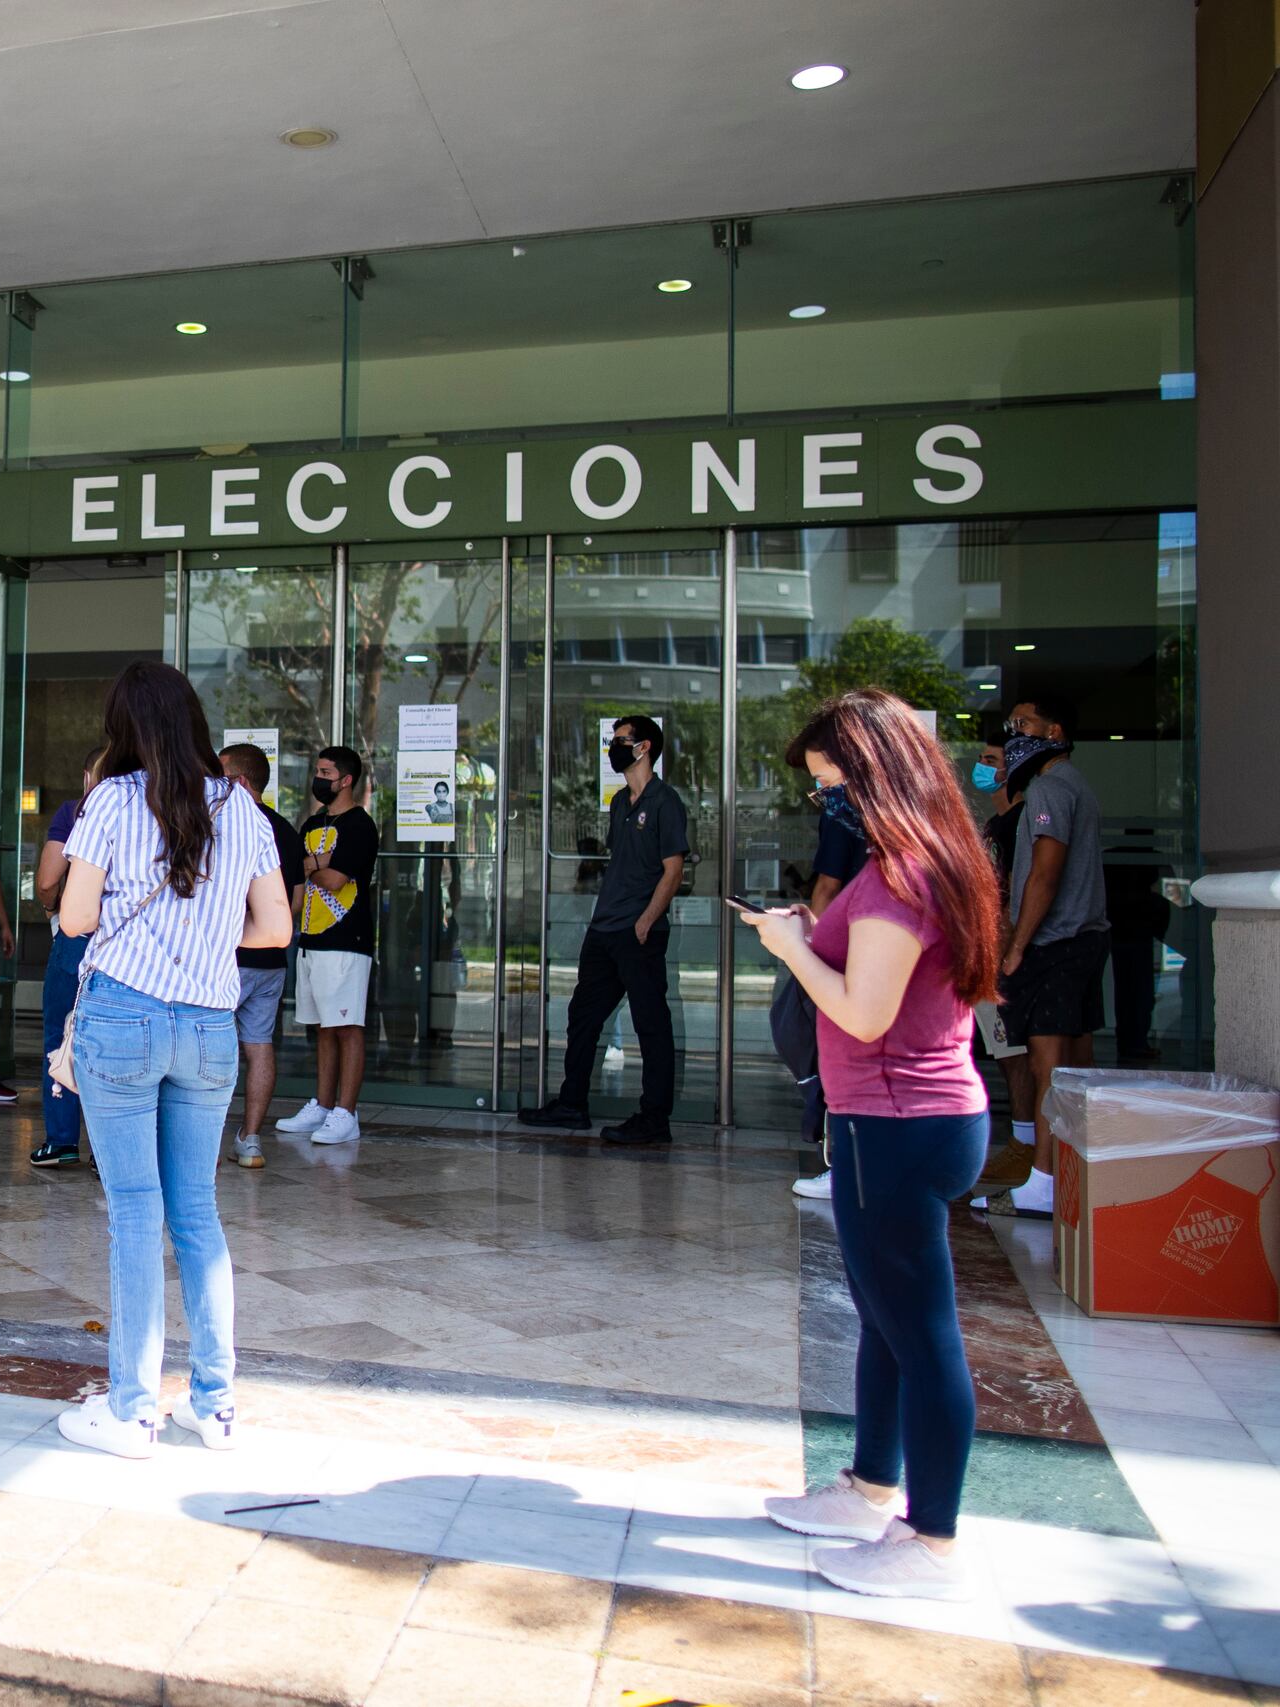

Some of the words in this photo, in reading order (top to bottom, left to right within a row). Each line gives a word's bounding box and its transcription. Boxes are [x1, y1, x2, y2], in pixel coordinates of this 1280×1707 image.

[71, 424, 984, 541] ELECCIONES
[1188, 1209, 1214, 1223] THE
[1174, 1215, 1240, 1242] HOME
[1164, 1240, 1186, 1255] More
[1192, 1233, 1232, 1250] DEPOT
[1159, 1247, 1181, 1262] More
